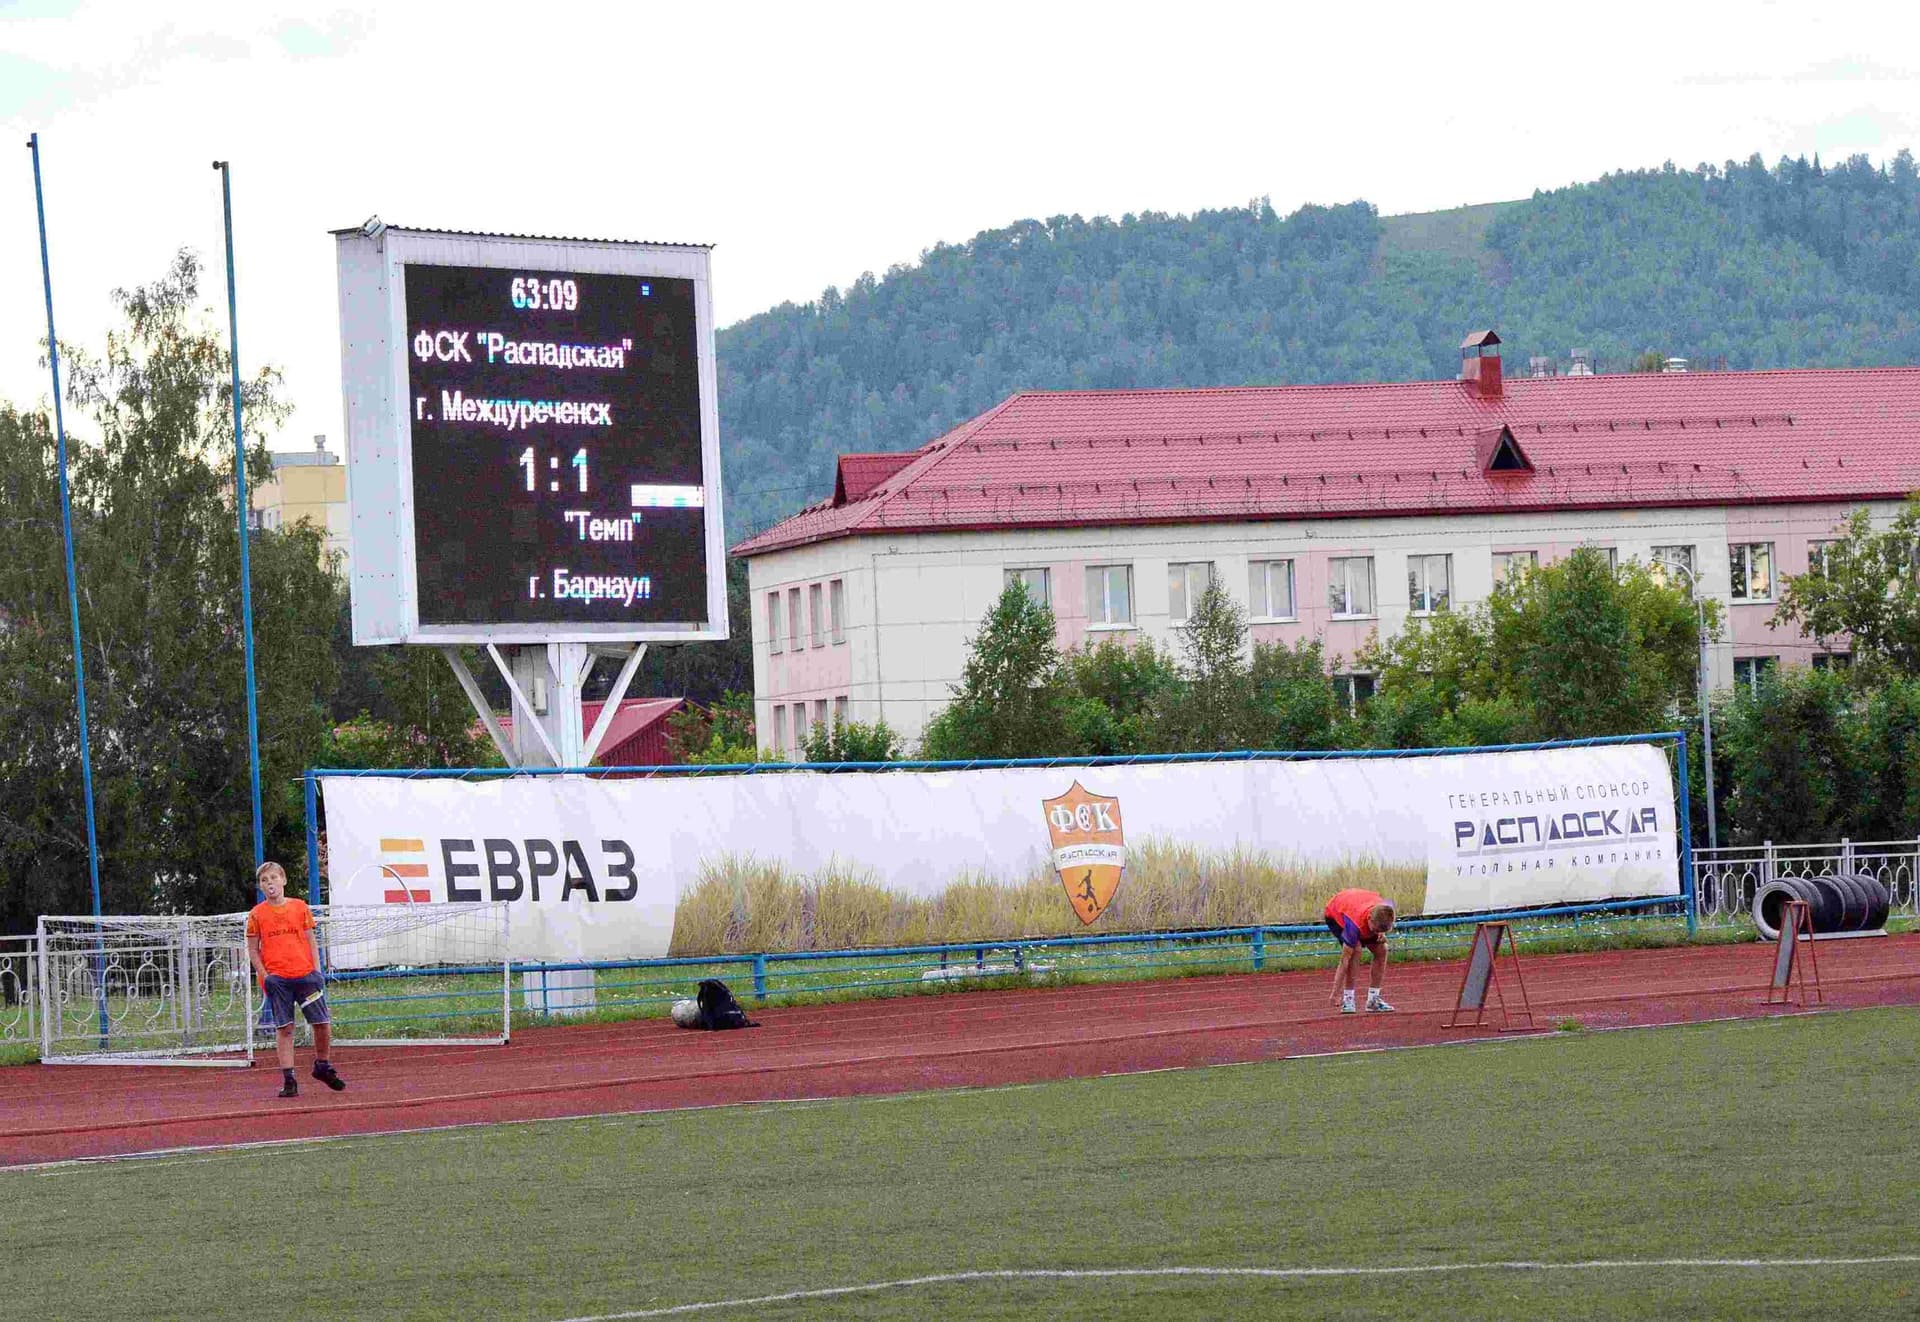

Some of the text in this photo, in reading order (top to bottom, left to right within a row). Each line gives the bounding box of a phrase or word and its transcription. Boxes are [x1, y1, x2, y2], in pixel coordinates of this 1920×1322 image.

[511, 277, 578, 311] 63:09
[414, 330, 632, 369] ФСК "Распадская"
[416, 390, 613, 430] г. Междуреченск
[564, 511, 641, 541] "Темп"
[529, 569, 651, 606] г. Барнаул
[1448, 781, 1649, 809] ГЕНЕРАЛЬНЫЙ СПОНСОР
[1050, 802, 1118, 833] ФСК
[1454, 807, 1658, 848] РАСПАДСКАЯ
[440, 838, 638, 903] ЕВРАЗ
[1456, 849, 1662, 877] УГОЛЬНАЯ КОМПАНИЯ
